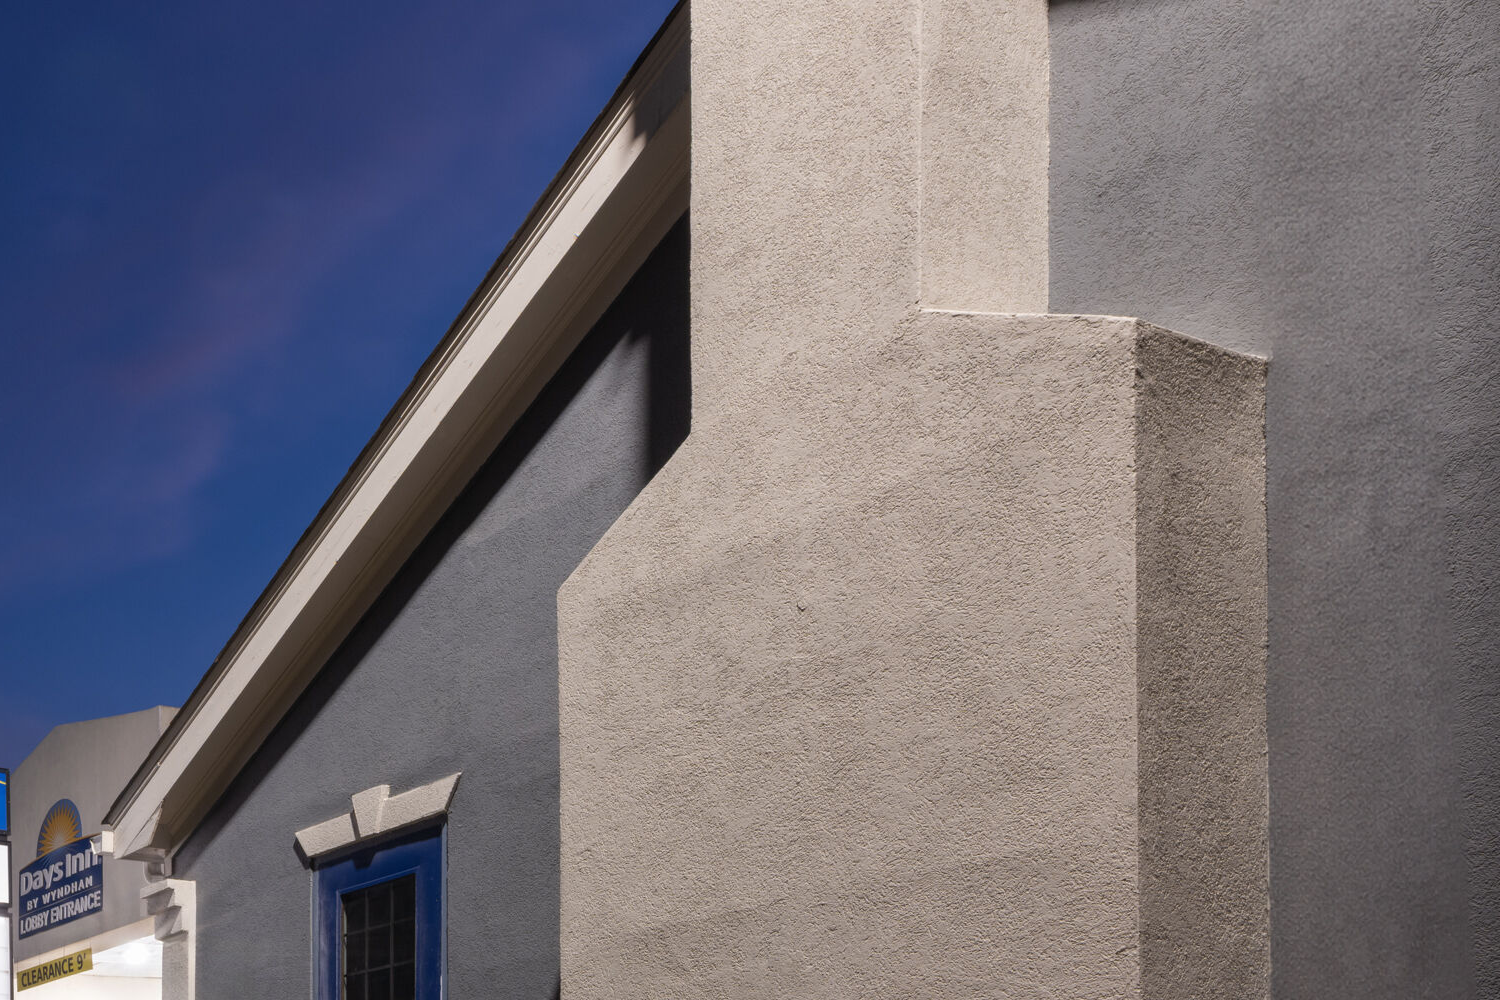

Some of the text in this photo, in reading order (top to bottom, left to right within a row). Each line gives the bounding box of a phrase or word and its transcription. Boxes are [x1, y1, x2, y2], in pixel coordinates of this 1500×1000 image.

[20, 860, 64, 896] Days
[27, 875, 93, 911] BY WYNDHAM
[20, 890, 101, 935] LOBBY ENTRANCE
[21, 960, 74, 987] CLEARANCE
